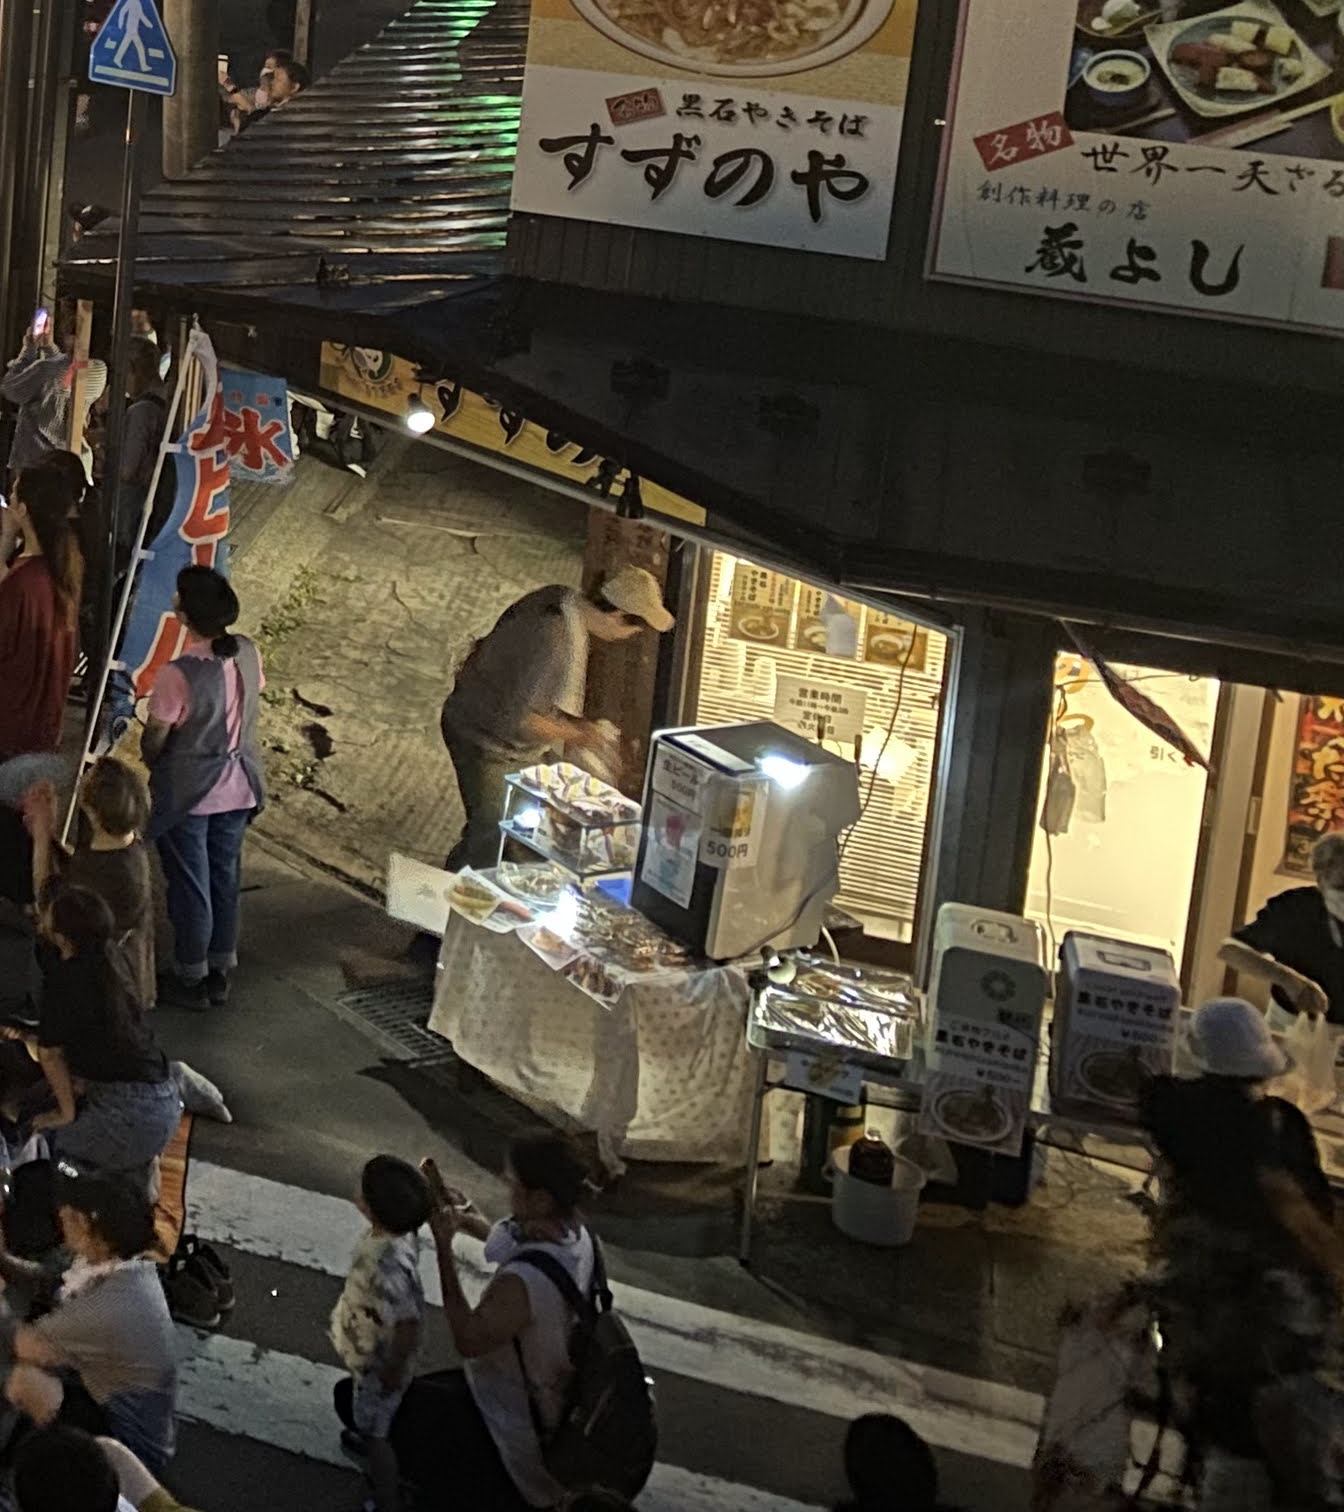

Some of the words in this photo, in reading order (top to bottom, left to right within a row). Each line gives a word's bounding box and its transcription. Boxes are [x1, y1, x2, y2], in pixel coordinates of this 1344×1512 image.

[675, 93, 869, 138] 黒石やきそば
[989, 119, 1063, 161] 名物
[538, 122, 870, 223] すずのや
[976, 179, 1153, 222] 創作料理の店
[1024, 222, 1246, 297] 蔵よし
[798, 687, 842, 704] 営業時間
[706, 841, 749, 858] 500円
[1077, 991, 1172, 1019] 黒石やきそば
[935, 1029, 1027, 1061] 黒石やきそば
